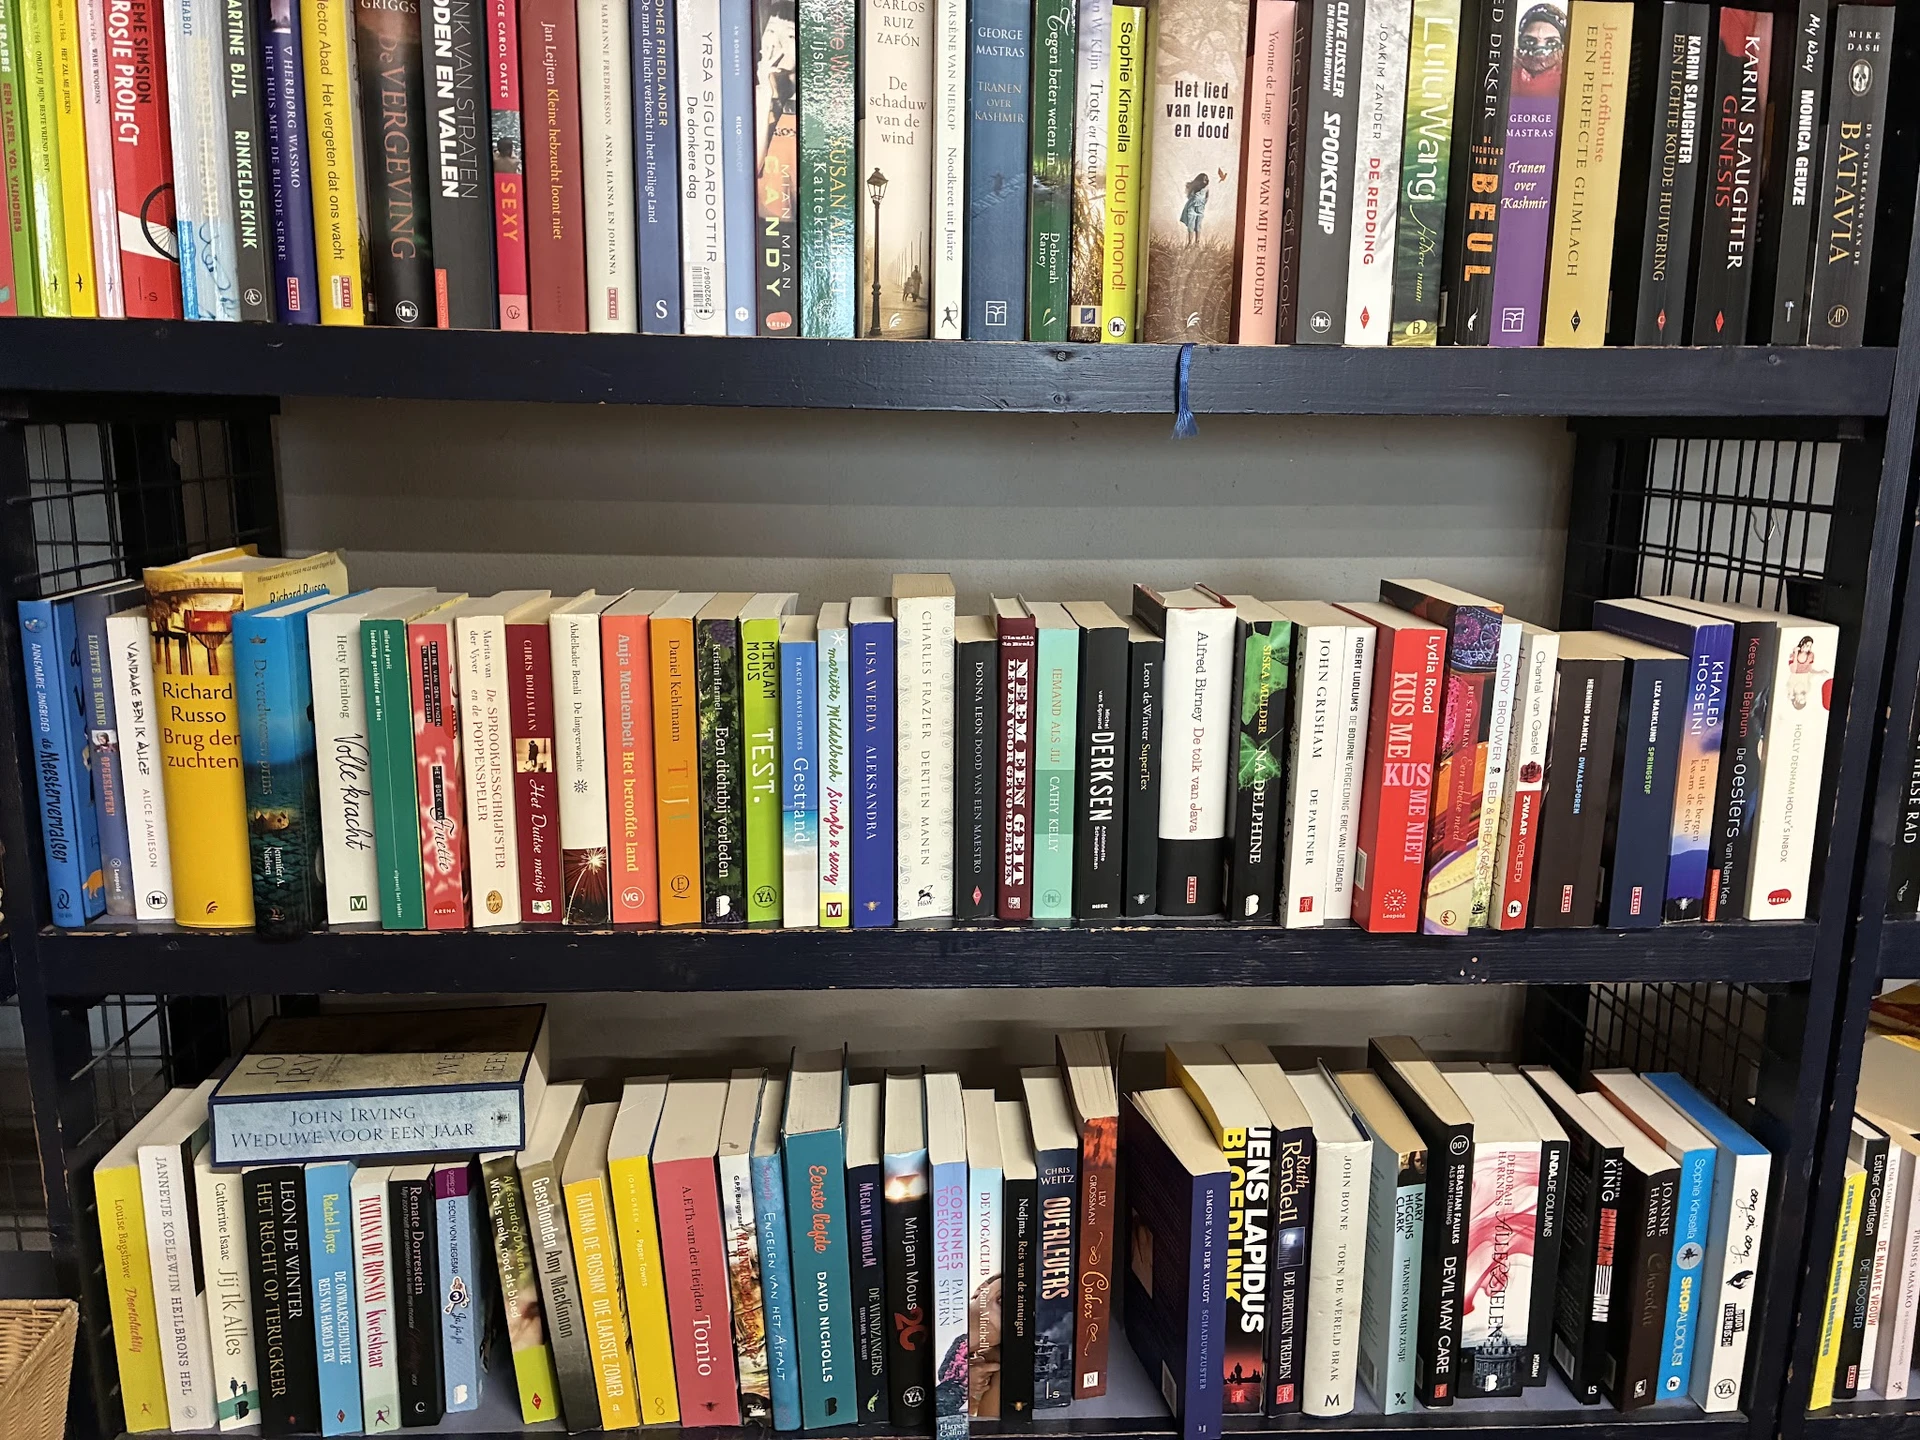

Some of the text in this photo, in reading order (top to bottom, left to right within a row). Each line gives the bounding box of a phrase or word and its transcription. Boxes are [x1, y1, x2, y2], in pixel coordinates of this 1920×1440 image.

[888, 77, 907, 90] De
[1175, 81, 1228, 99] Het lied
[1323, 4, 1335, 90] EN GRAHAM BROWN
[1333, 2, 1349, 97] CLIVE CUSSLER
[284, 60, 300, 188] HERBJØRG WASSMO
[541, 22, 563, 239] Jan Leijten Kleine hebzucht loont niet
[685, 97, 700, 199] De donkere dag
[701, 32, 717, 262] YRSA SIGURDARDOTTIR
[870, 97, 926, 110] schaduw
[876, 115, 921, 128] van de
[881, 134, 914, 145] wind
[1166, 105, 1233, 120] van leven
[1175, 123, 1229, 139] en dood
[1363, 23, 1387, 265] JOAKIM ZANDER DE REDDING
[1792, 14, 1821, 205] My Way MONICA GEUZE
[234, 130, 257, 248] RINKELDEKINK
[1111, 21, 1133, 291] Sophie Kinsella Hou je mond!
[1318, 111, 1340, 234] SPOOKSCHIP
[1715, 95, 1737, 207] GENESIS
[1727, 35, 1760, 270] KARIN SLAUGHTER
[1828, 121, 1861, 264] BATAVIA
[501, 182, 518, 242] SEXY
[765, 155, 780, 297] CANDY
[781, 164, 791, 289] MIAN MIAN
[162, 682, 233, 700] Richard
[337, 635, 352, 718] Hetty Kleinloog
[747, 642, 759, 681] MOUS
[761, 641, 775, 698] MIRJAM
[1258, 645, 1271, 734] SISKA MULDER
[1423, 636, 1440, 713] Lydia Rood
[32, 643, 68, 863] ANNEMARIE JONGBLOED de Meestervervalser
[164, 729, 239, 751] Brug der
[171, 706, 227, 722] Russo
[616, 634, 639, 872] Anja Meulenbelt Het beroofde land
[1388, 672, 1417, 758] KUS ME
[1573, 679, 1593, 814] HENNING MANKELL DWAALSPOREN
[1644, 681, 1662, 794] LIZA MARKLUND SPRINGSTOF
[168, 753, 238, 768] zuchten
[333, 735, 373, 850] Volle kracht
[752, 728, 774, 804] TEST.
[1048, 668, 1062, 852] IEMAND ALS JIJ CATHY KELLY
[1089, 732, 1114, 821] DERKSEN
[1383, 762, 1430, 786] KUS
[1780, 724, 1803, 862] HOLLY DENHAM HOLLY'S INBOX
[1250, 749, 1267, 863] NA DELPHINE
[1404, 789, 1427, 863] ME NIET
[1903, 812, 1918, 843] RAD
[231, 1123, 474, 1148] WEDUWE VOOR EEN JAAR
[291, 1106, 416, 1127] JOHN IRVING
[1041, 1176, 1075, 1184] WEITZ
[1396, 1197, 1405, 1233] CLARK
[1404, 1195, 1414, 1239] HIGGINS
[1414, 1192, 1423, 1221] MARY
[1646, 1187, 1660, 1237] HARRIS
[1659, 1181, 1674, 1237] JOANNE
[280, 1181, 302, 1319] LEON DE WINTER
[411, 1187, 426, 1295] Renate Dorrestein
[531, 1177, 573, 1338] Geschonden Amy MacKinnon
[937, 1186, 949, 1270] TOEKOMST
[951, 1186, 963, 1269] CORINNES
[1042, 1197, 1070, 1300] OVERLEVERS
[1241, 1126, 1271, 1332] JENS LAPIDUS
[1853, 1154, 1885, 1328] Esther Gerritsen DE TROOSTER
[257, 1183, 287, 1398] HET RECHT OP TERUGKEER
[809, 1165, 833, 1382] Eerste liefde DAVID NICHOLLS
[939, 1279, 950, 1327] STERN
[952, 1279, 963, 1325] PAULA
[1397, 1258, 1410, 1362] TRANEN OM MIJN ZUSJE
[1435, 1257, 1457, 1374] DEVIL MAY CARE
